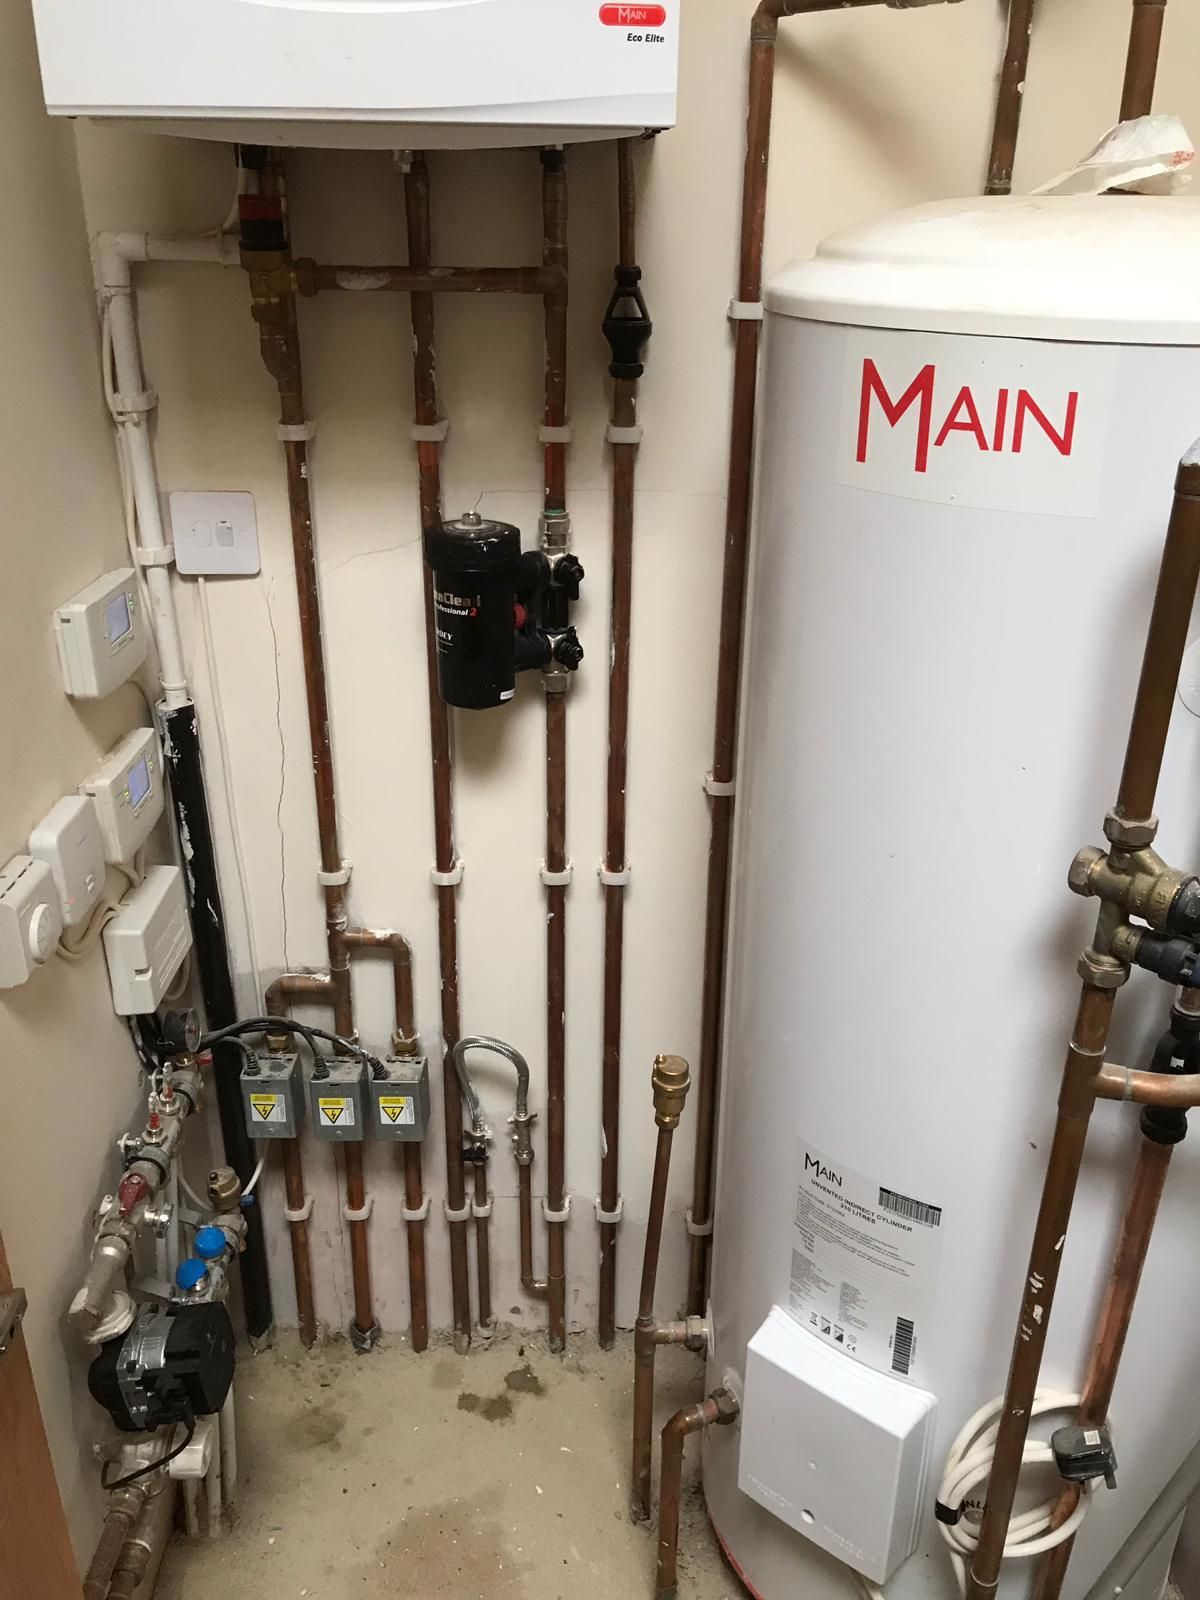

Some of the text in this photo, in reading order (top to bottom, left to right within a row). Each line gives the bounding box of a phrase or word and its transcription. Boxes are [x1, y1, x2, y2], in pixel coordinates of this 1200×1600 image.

[618, 7, 647, 23] MAIN
[627, 33, 665, 43] Eco Elite
[856, 358, 1079, 473] MAIN
[469, 607, 478, 617] 2
[804, 1152, 842, 1187] MAIN
[811, 1179, 844, 1201] UNVENTED
[844, 1199, 875, 1217] INDIRECT
[876, 1214, 913, 1232] CYLINDER
[852, 1209, 876, 1224] LITRES
